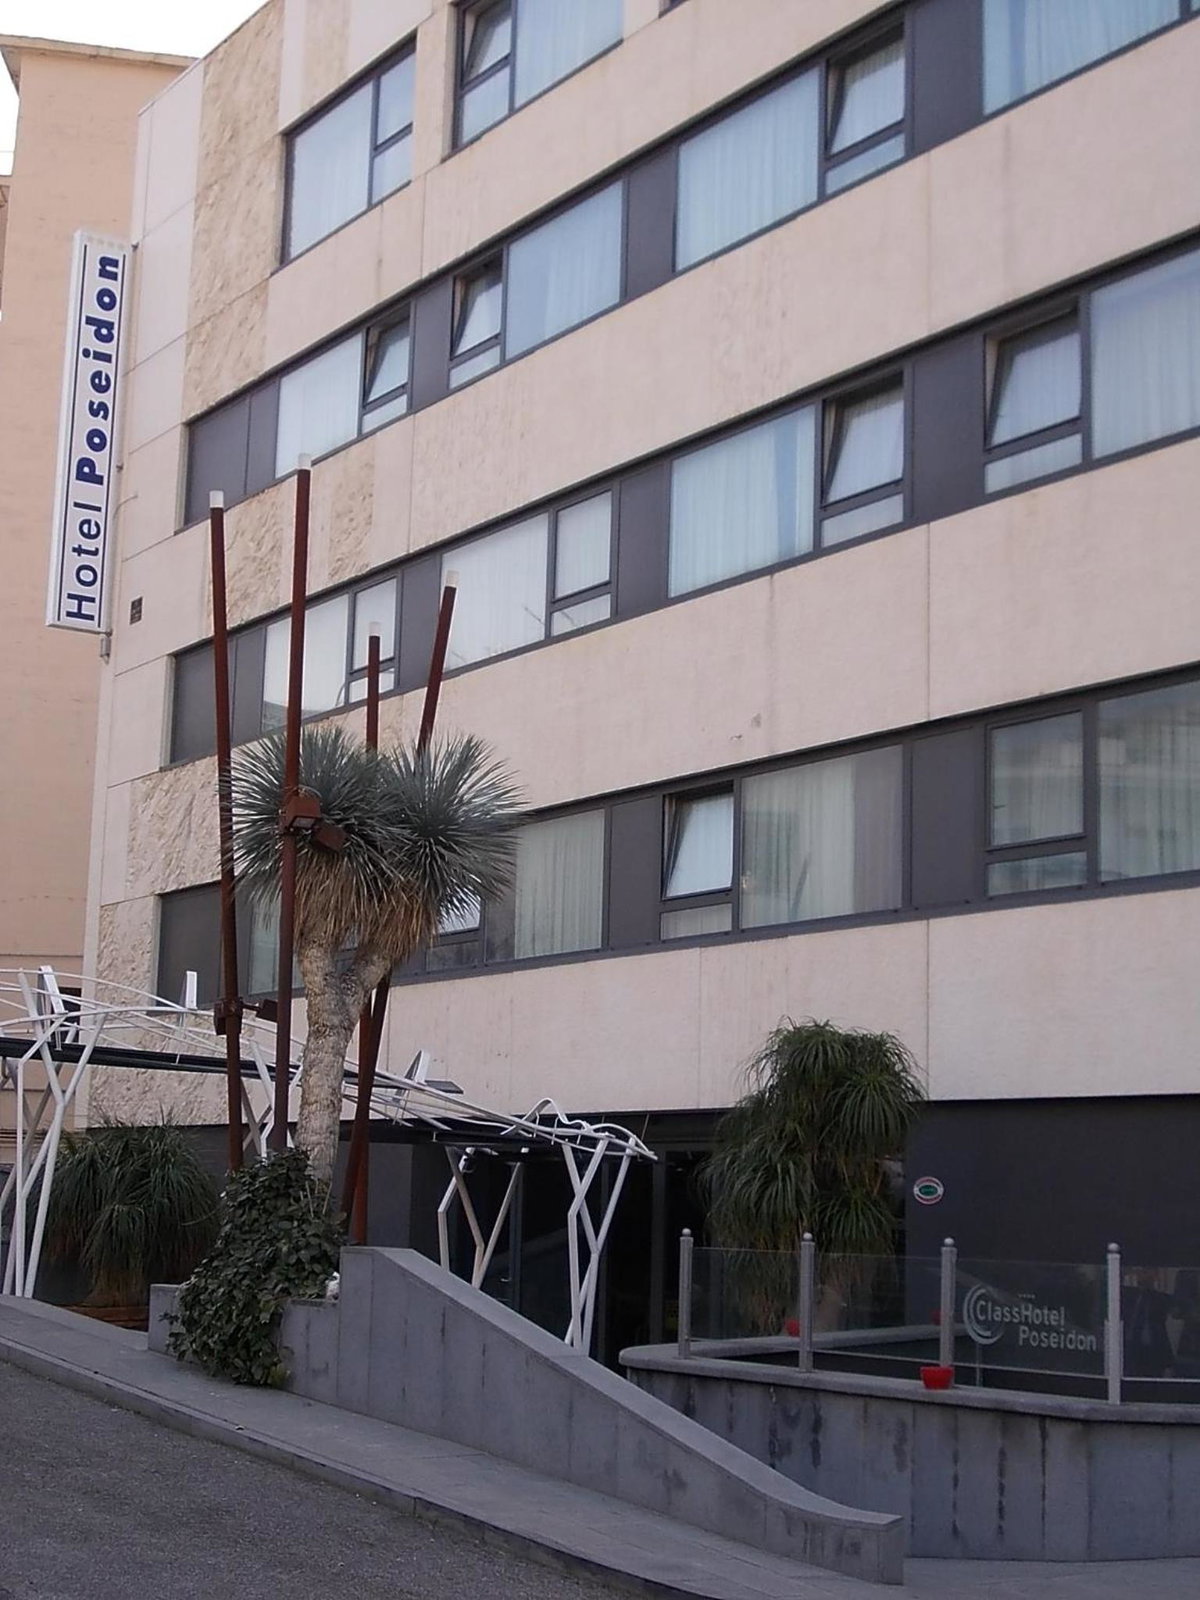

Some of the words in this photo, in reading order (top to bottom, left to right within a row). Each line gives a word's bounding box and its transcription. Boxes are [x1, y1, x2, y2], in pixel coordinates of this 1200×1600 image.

[75, 255, 120, 486] Poseidon
[65, 501, 102, 622] Hotel
[1018, 1326, 1097, 1351] Poseidon
